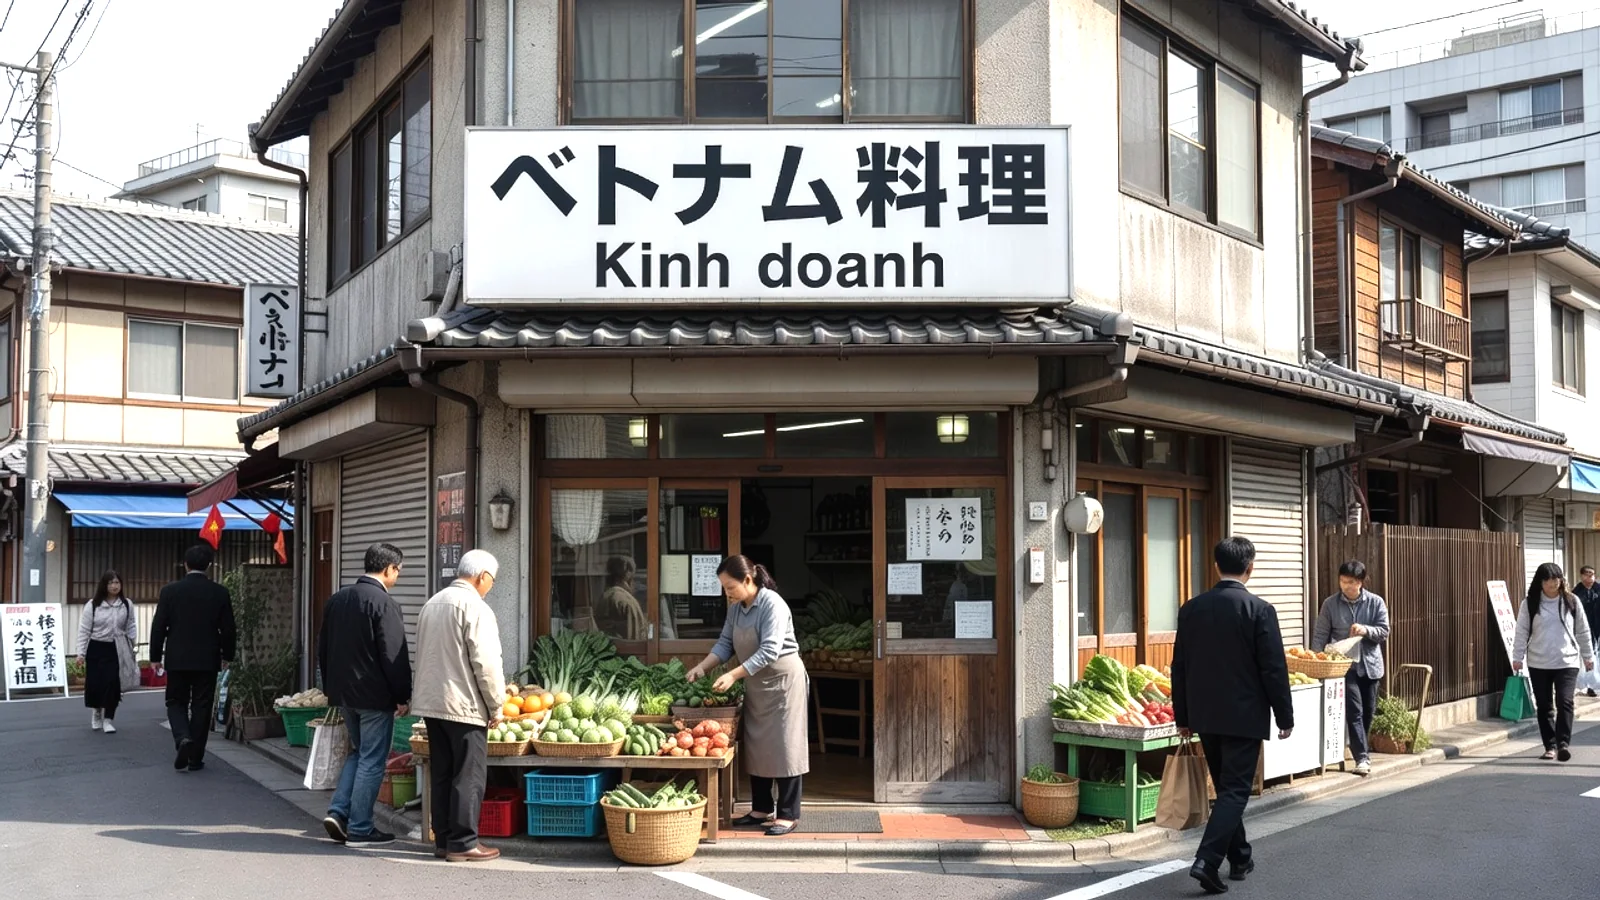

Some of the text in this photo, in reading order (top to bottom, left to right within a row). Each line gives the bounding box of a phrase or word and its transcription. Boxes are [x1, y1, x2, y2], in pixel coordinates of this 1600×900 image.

[490, 140, 1049, 229] ベトナム料理
[596, 242, 944, 289] Kinh doanh
